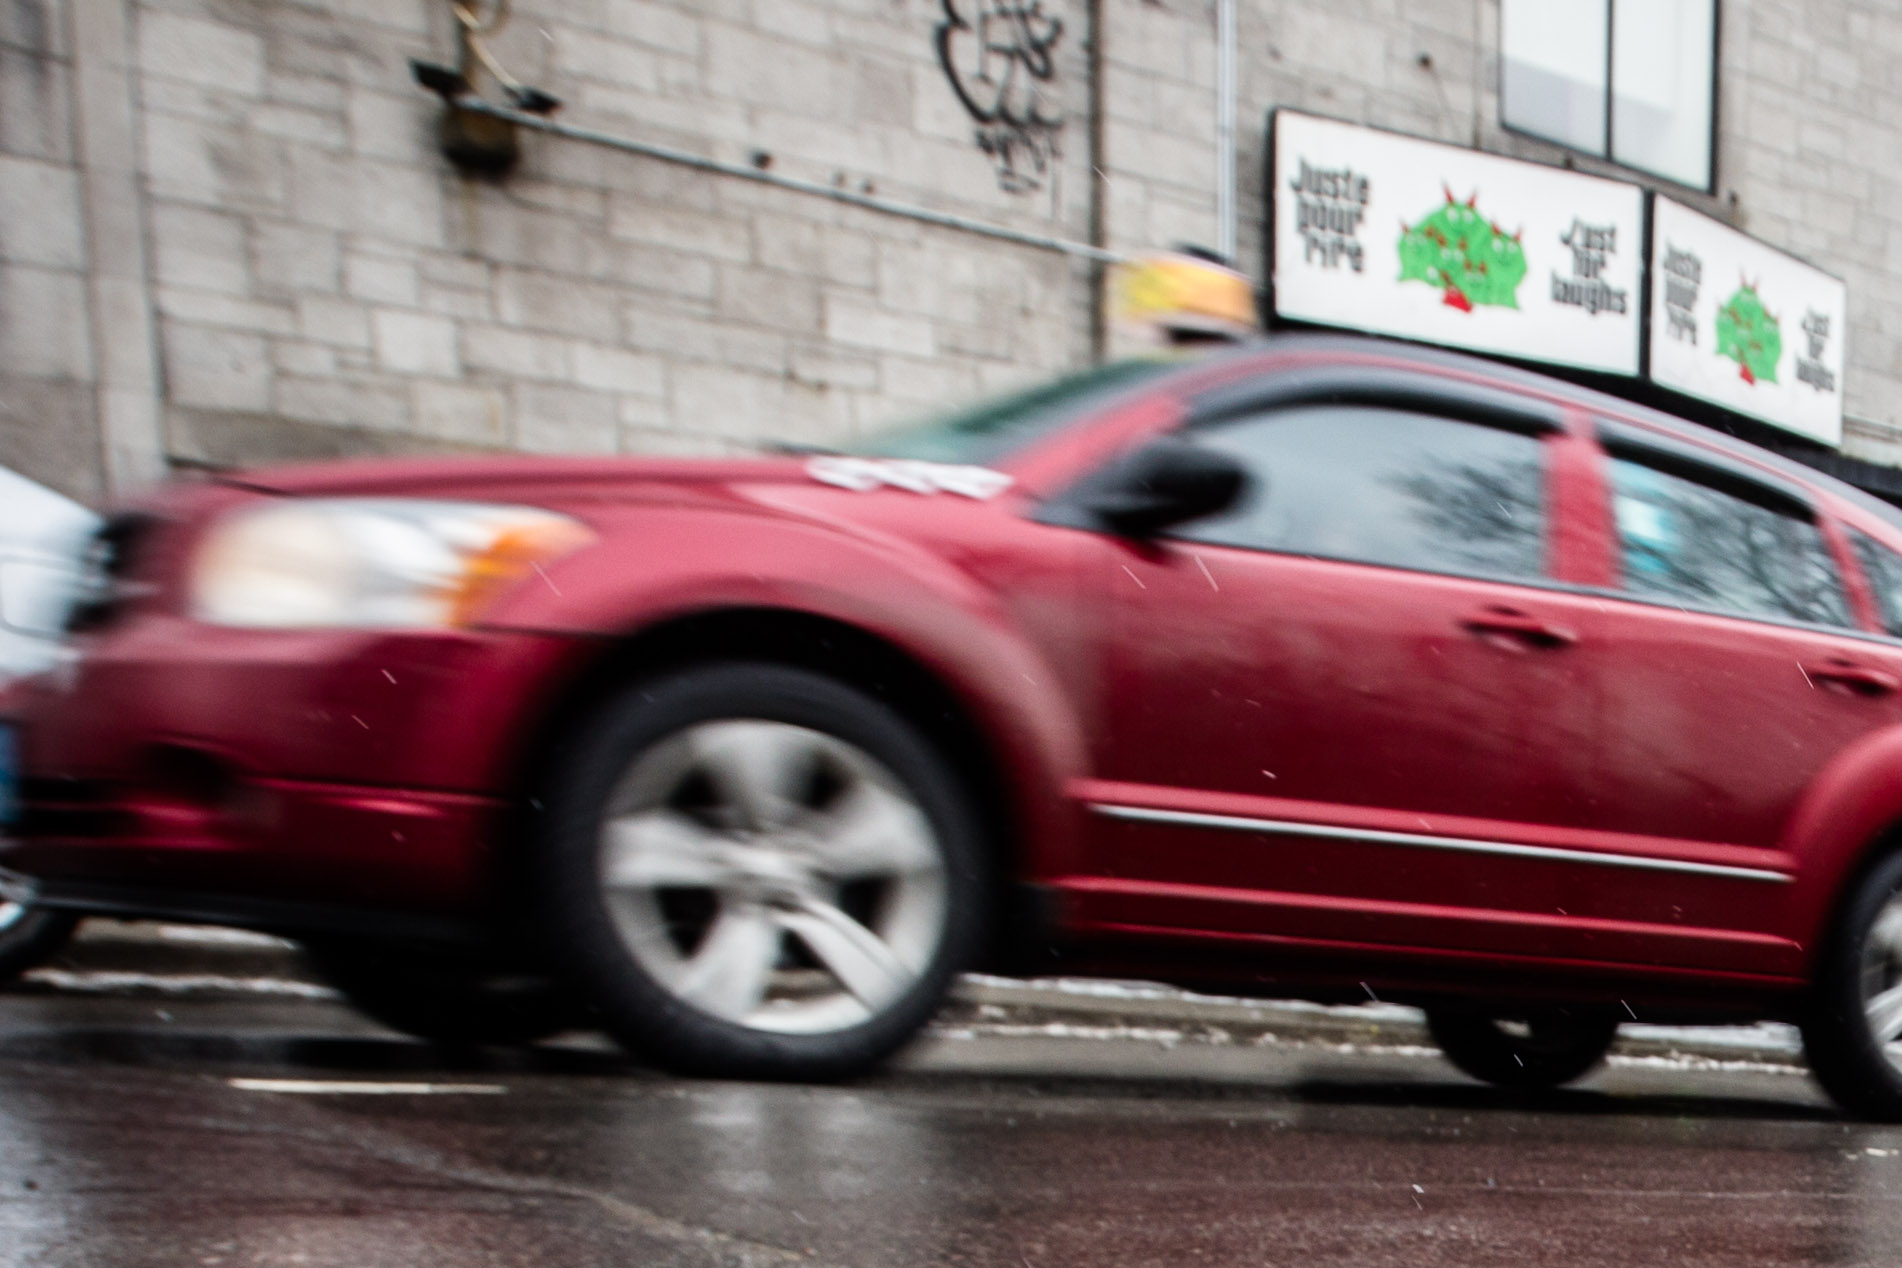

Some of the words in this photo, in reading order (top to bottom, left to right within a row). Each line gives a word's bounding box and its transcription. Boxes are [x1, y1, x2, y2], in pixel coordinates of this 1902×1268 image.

[1289, 157, 1369, 206] Juste
[1297, 199, 1364, 236] pour
[1559, 217, 1616, 254] Just
[1304, 235, 1365, 273] rire
[1574, 247, 1606, 279] for
[1551, 271, 1627, 315] laughs
